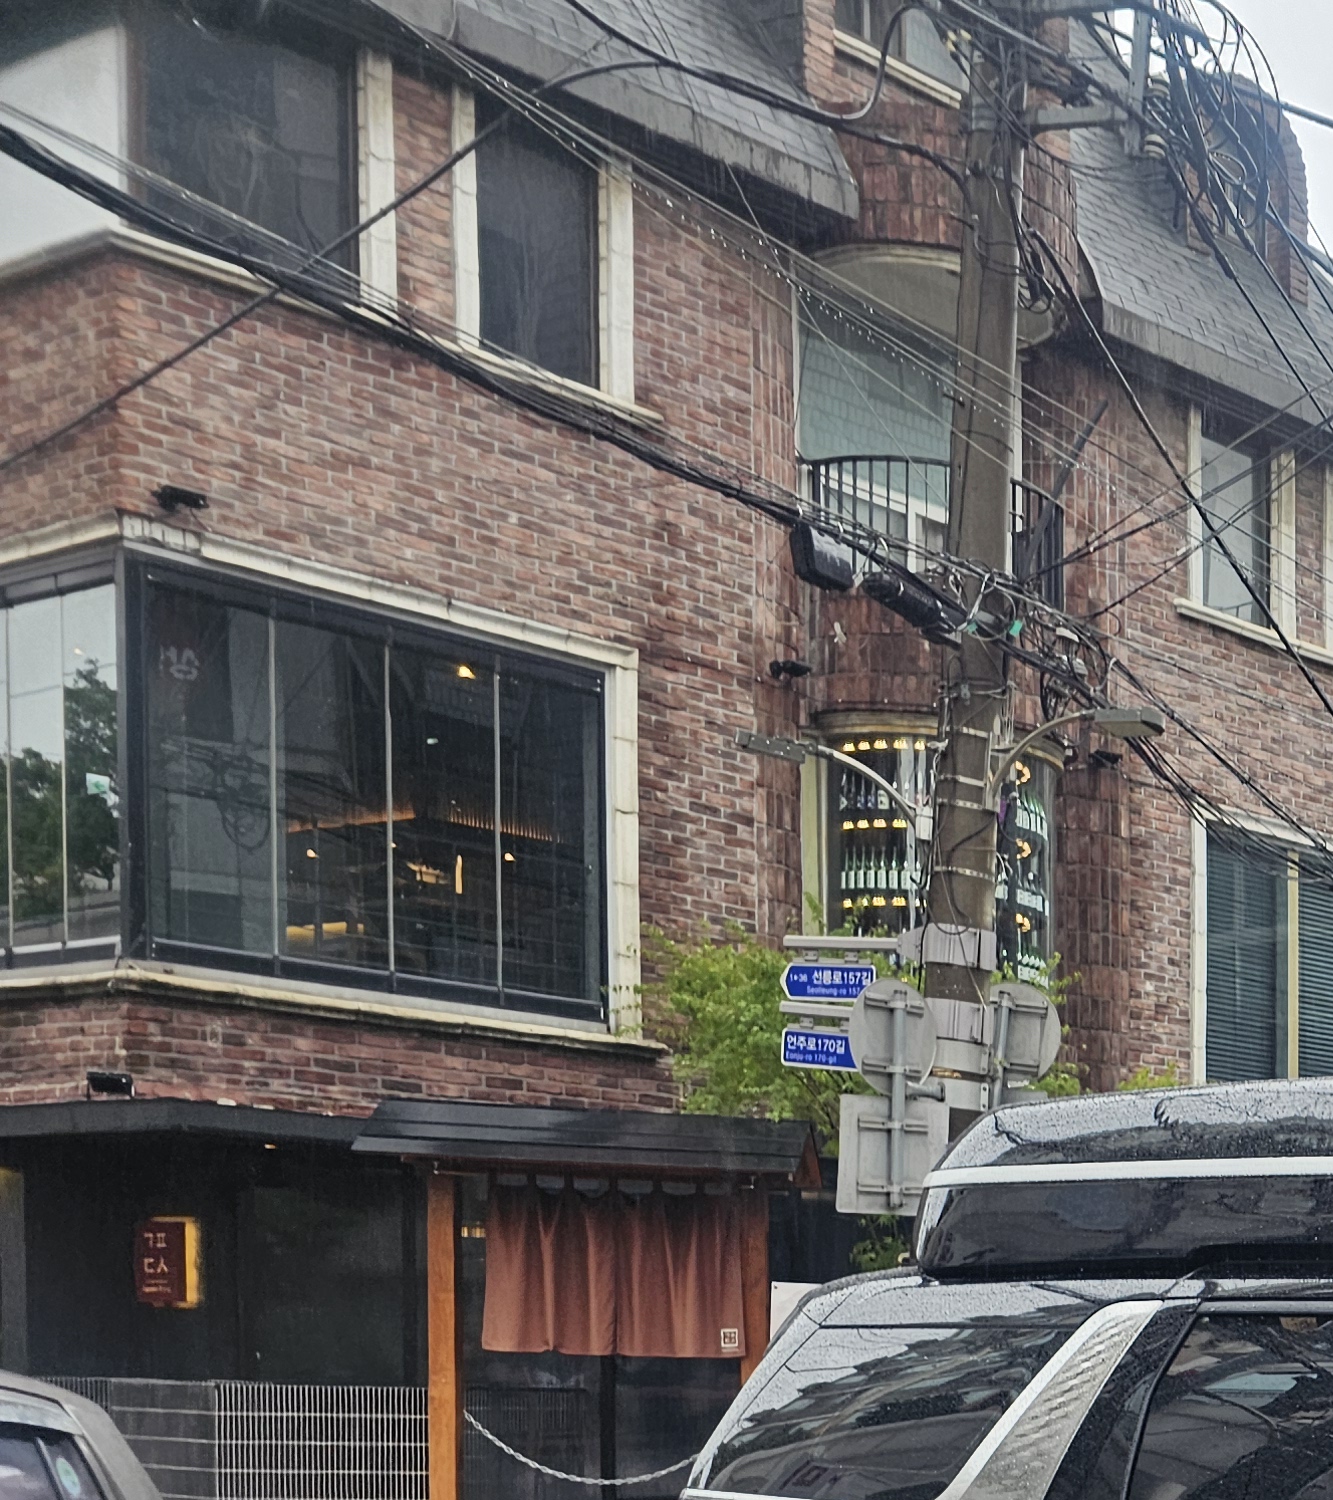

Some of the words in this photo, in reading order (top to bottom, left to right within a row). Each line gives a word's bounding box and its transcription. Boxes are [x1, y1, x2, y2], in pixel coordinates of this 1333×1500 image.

[786, 1034, 846, 1055] 언주로170길
[785, 1051, 813, 1062] Eonju-ro
[814, 1053, 837, 1065] 170-gil
